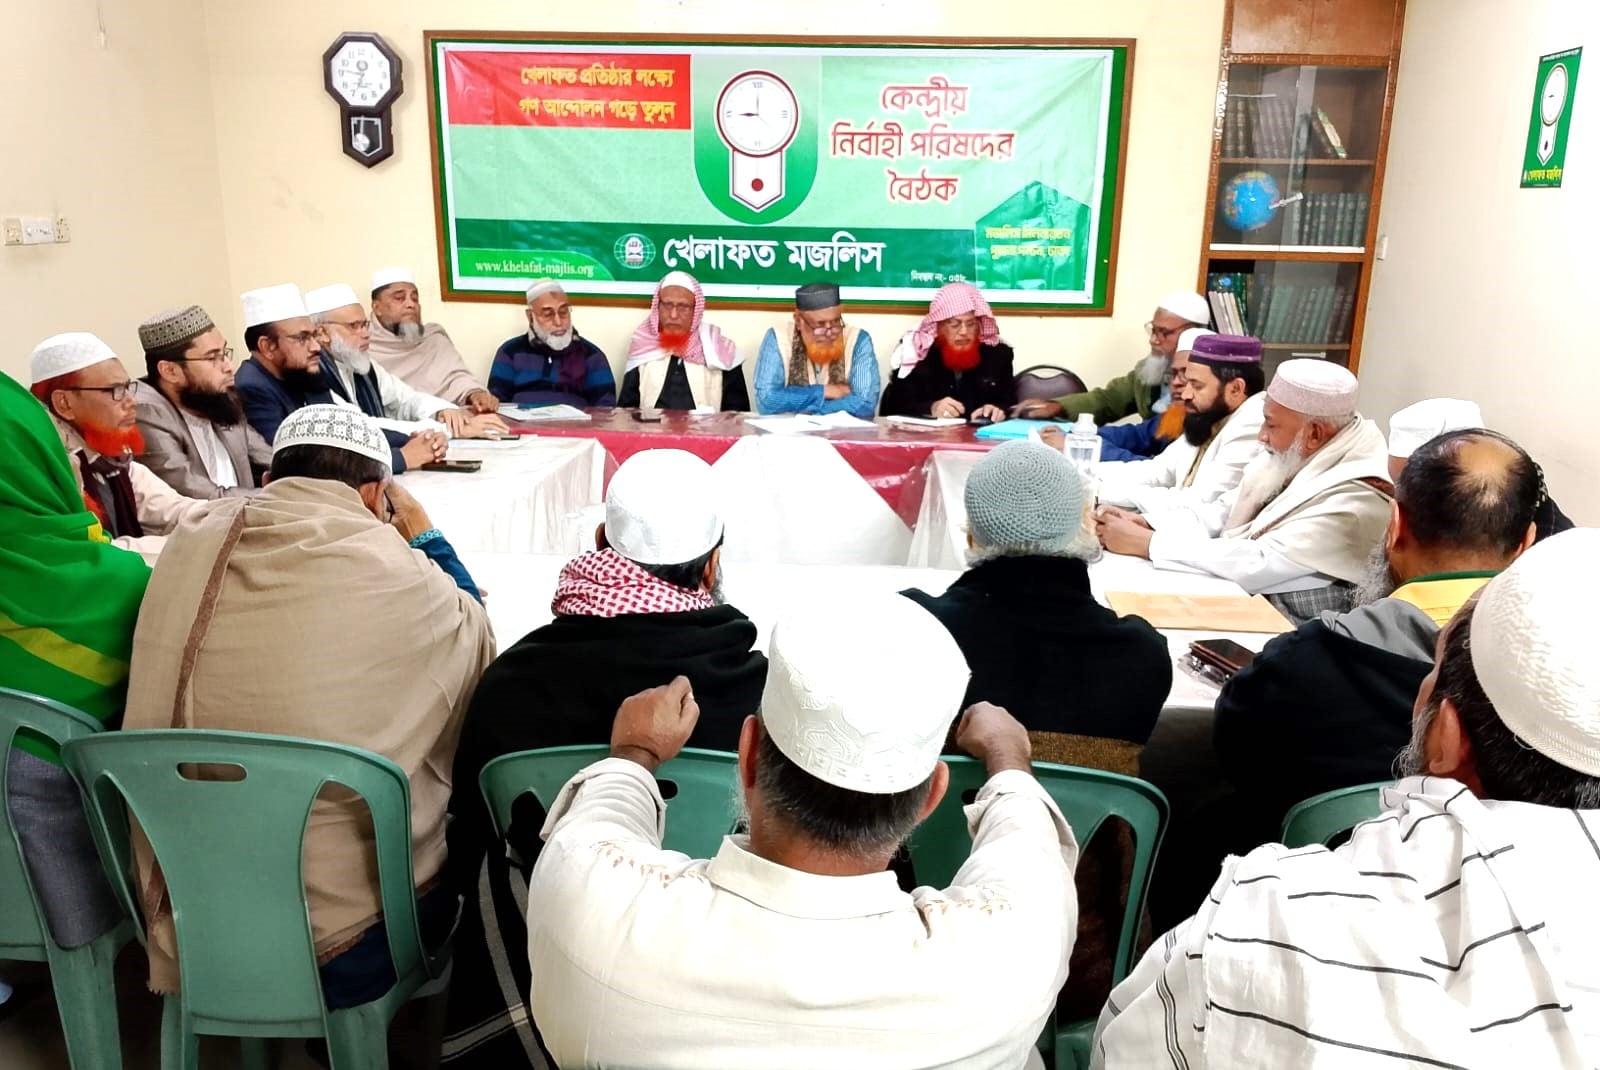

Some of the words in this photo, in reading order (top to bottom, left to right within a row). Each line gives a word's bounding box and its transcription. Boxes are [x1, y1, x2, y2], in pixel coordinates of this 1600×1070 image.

[521, 65, 578, 85] খেলাফত
[580, 61, 633, 87] প্রতিষ্ঠার
[635, 68, 675, 88] লক্ষ্যে
[519, 97, 540, 116] গণ
[543, 97, 605, 118] আন্দোলন
[609, 98, 638, 121] গড়ে
[640, 100, 676, 124] তুলুন
[882, 76, 968, 117] কেন্দ্রীয়
[831, 121, 903, 158] নির্বাহী
[911, 123, 1015, 160] পরিষদের
[887, 168, 958, 201] বৈঠক
[663, 234, 779, 270] খেলাফত
[784, 230, 887, 272] মজলিস
[475, 260, 594, 278] www.khelafat-majlis.org
